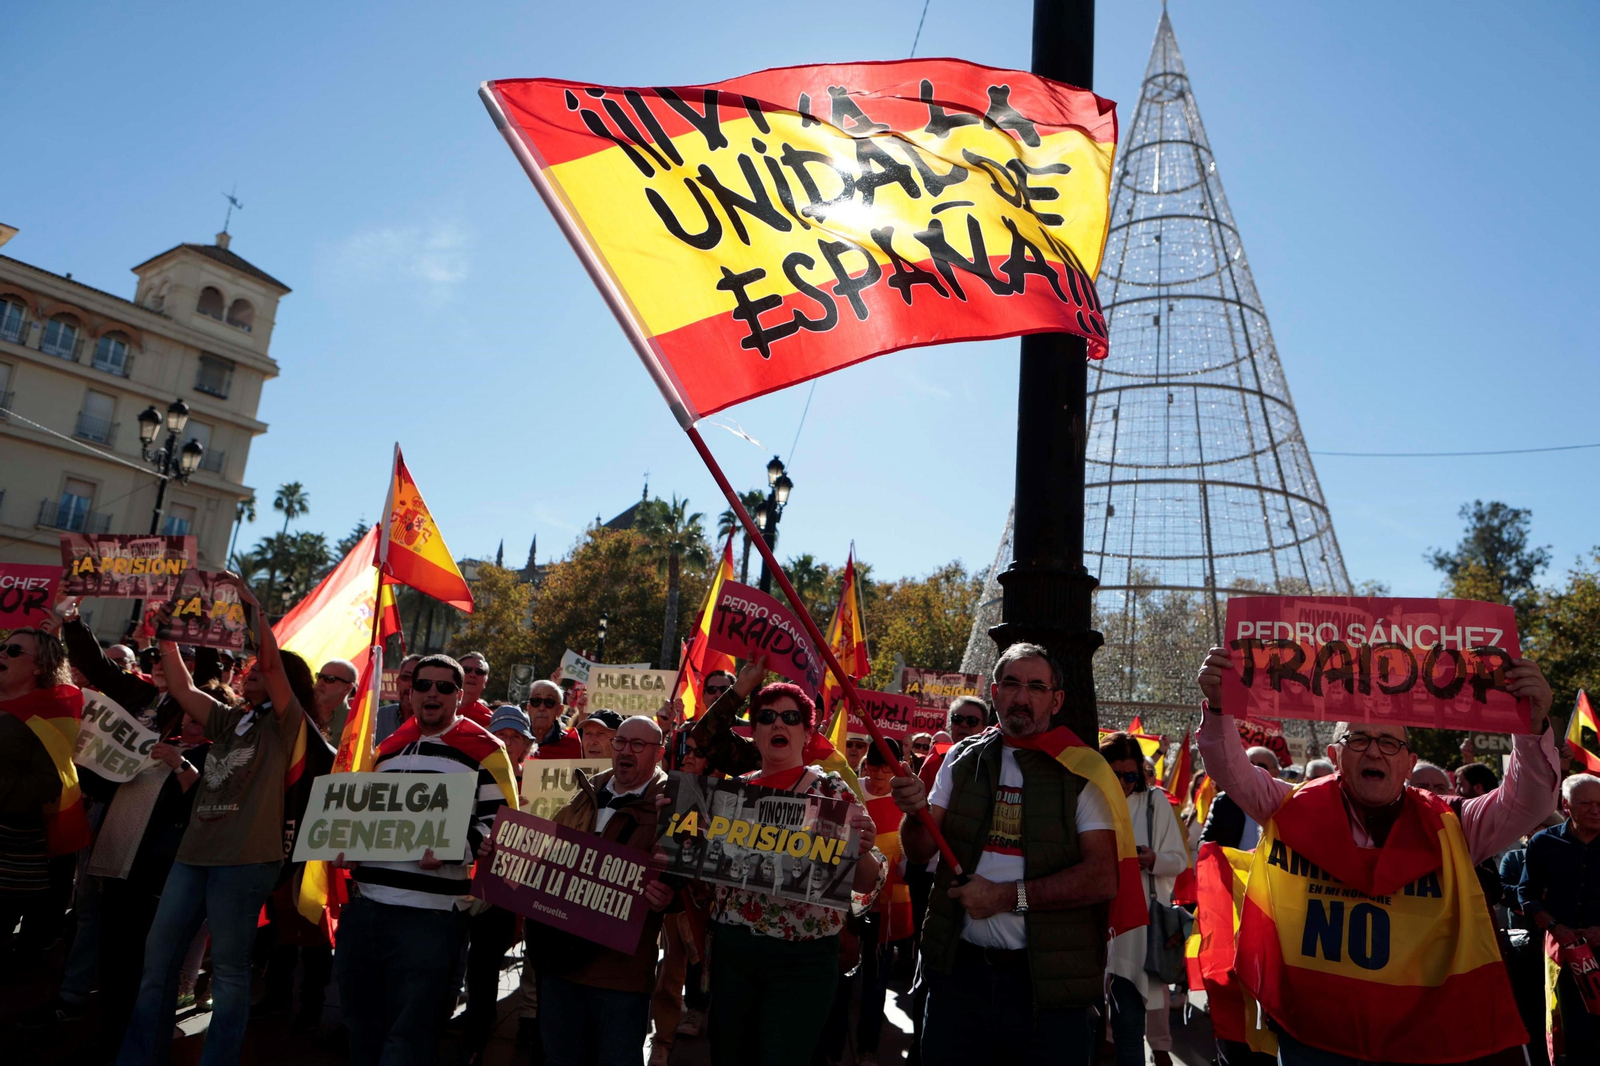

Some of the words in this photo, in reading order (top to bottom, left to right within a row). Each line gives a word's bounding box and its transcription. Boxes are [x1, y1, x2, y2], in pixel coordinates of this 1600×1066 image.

[919, 78, 1042, 147] LA
[961, 148, 1072, 226] DE
[72, 556, 95, 576] ¡A
[101, 554, 189, 575] PRISIÓN!
[722, 594, 769, 618] PEDRO
[768, 613, 820, 679] SÁNCHEZ
[1236, 620, 1339, 646] PEDRO
[1346, 617, 1507, 652] SÁNCHEZ
[597, 672, 666, 691] HUELGA
[922, 684, 979, 697] PRISIÓN!
[1230, 638, 1521, 704] TRAIDOR
[323, 782, 450, 812] HUELGA
[307, 818, 451, 853] GENERAL
[495, 819, 580, 869] CONSUMADO
[579, 847, 598, 876] EL
[598, 854, 647, 896] GOLPE,
[665, 809, 698, 837] ¡A
[706, 814, 848, 866] PRISIÓN!
[489, 849, 546, 891] ESTALLA
[544, 868, 566, 897] LA
[564, 874, 634, 922] REVUELTA
[1308, 883, 1323, 894] EN
[1324, 886, 1340, 896] MI
[532, 900, 568, 920] Revuelta.
[1301, 899, 1390, 970] NO
